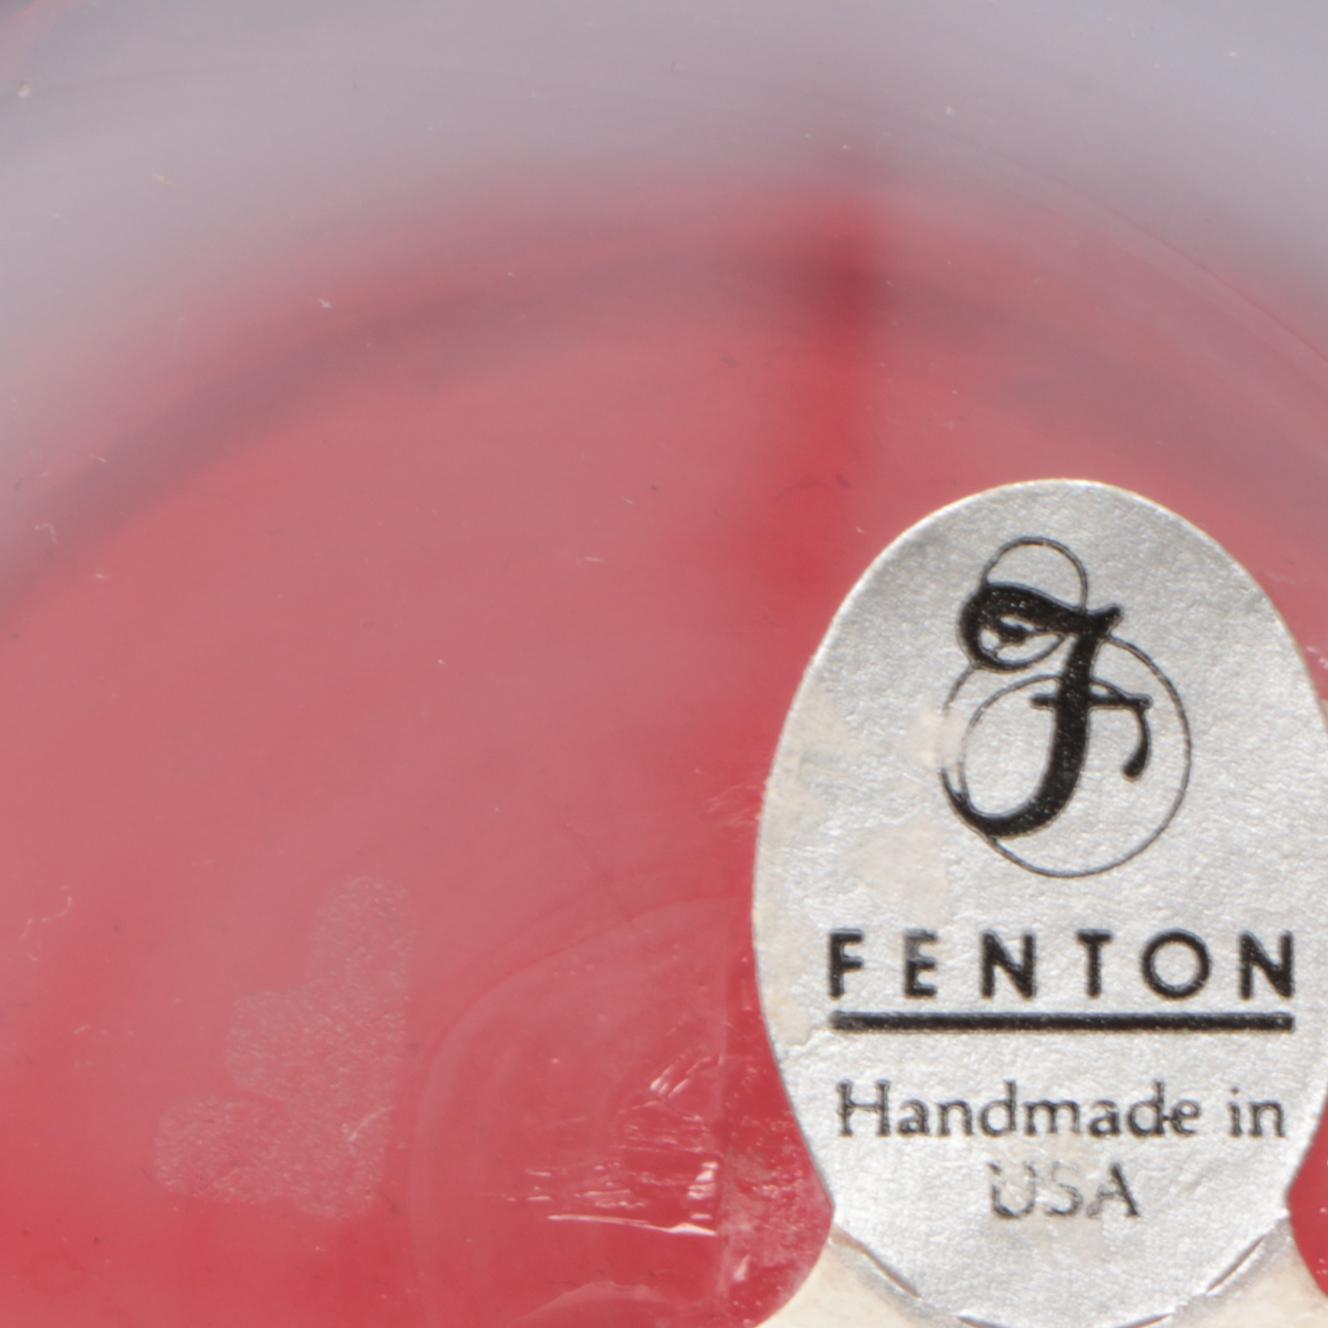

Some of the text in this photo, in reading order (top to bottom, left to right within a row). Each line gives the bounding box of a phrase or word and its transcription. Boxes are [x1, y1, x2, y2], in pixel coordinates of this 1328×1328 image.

[826, 929, 1297, 999] FENTON
[836, 1079, 1288, 1139] Handmade in
[989, 1162, 1142, 1218] USA
